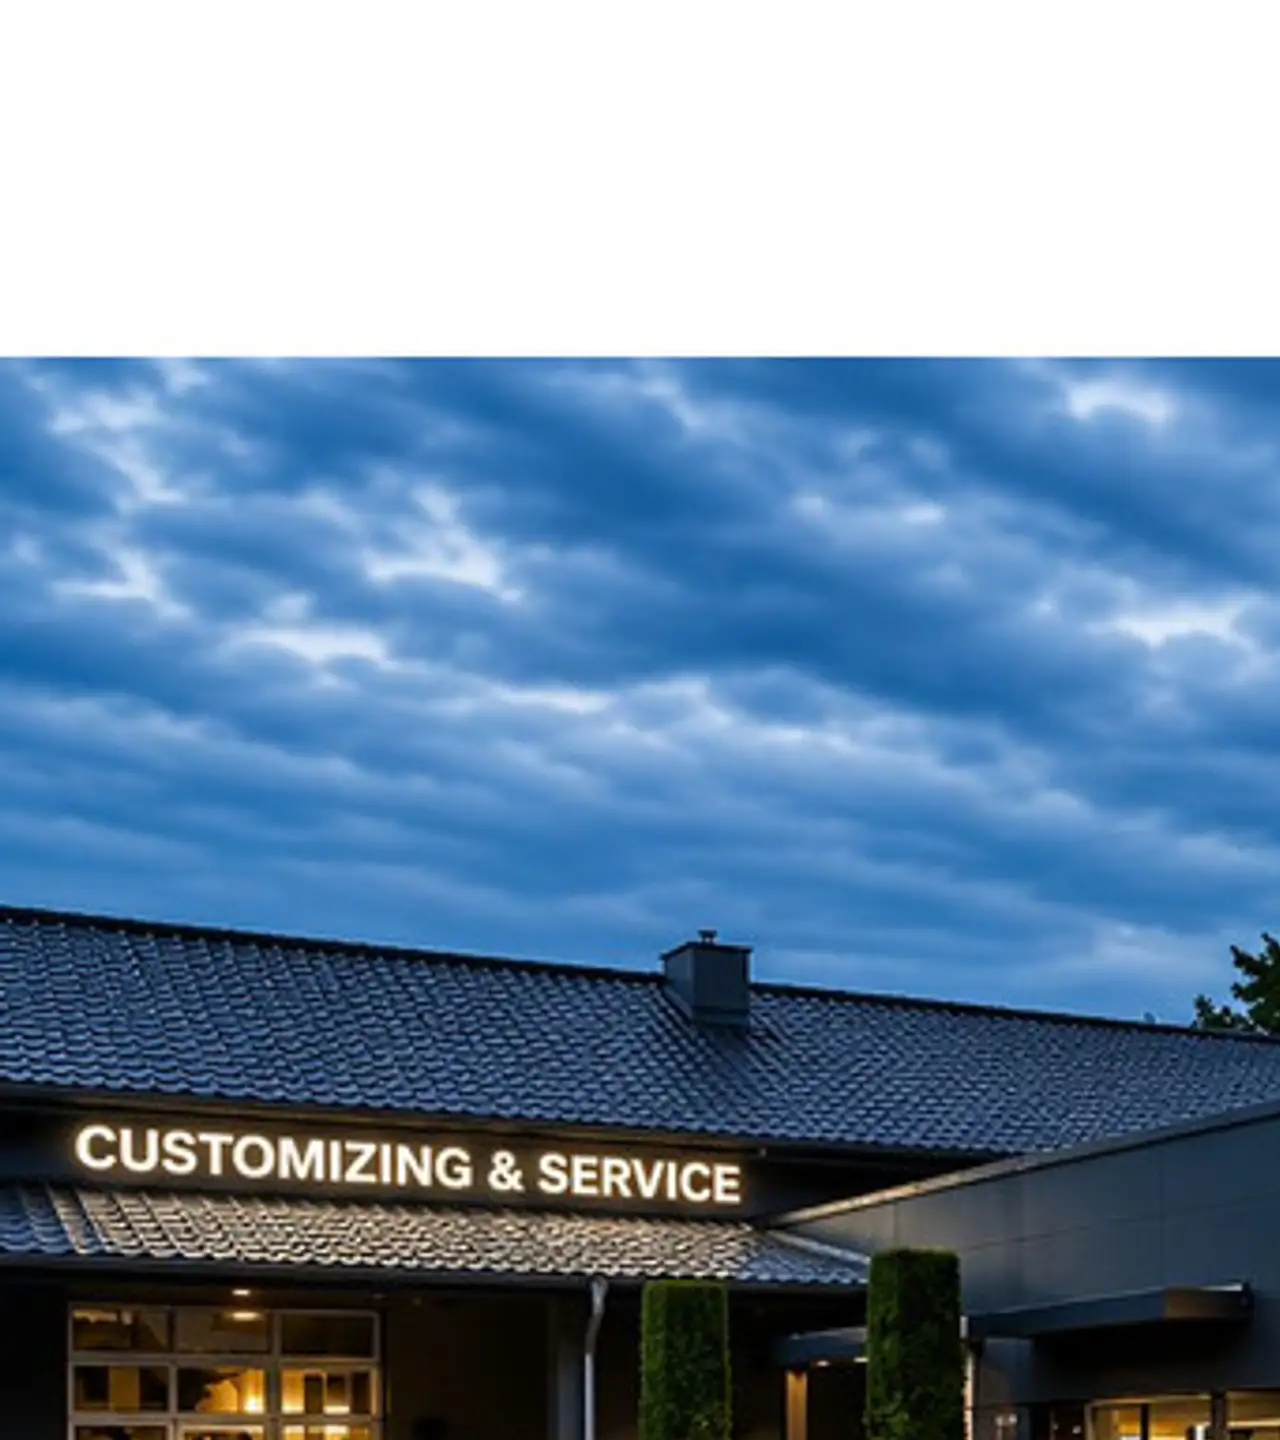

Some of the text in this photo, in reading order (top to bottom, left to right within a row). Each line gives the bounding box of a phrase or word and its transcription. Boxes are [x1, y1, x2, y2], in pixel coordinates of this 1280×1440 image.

[75, 1125, 741, 1203] CUSTOMIZING & SERVICE
